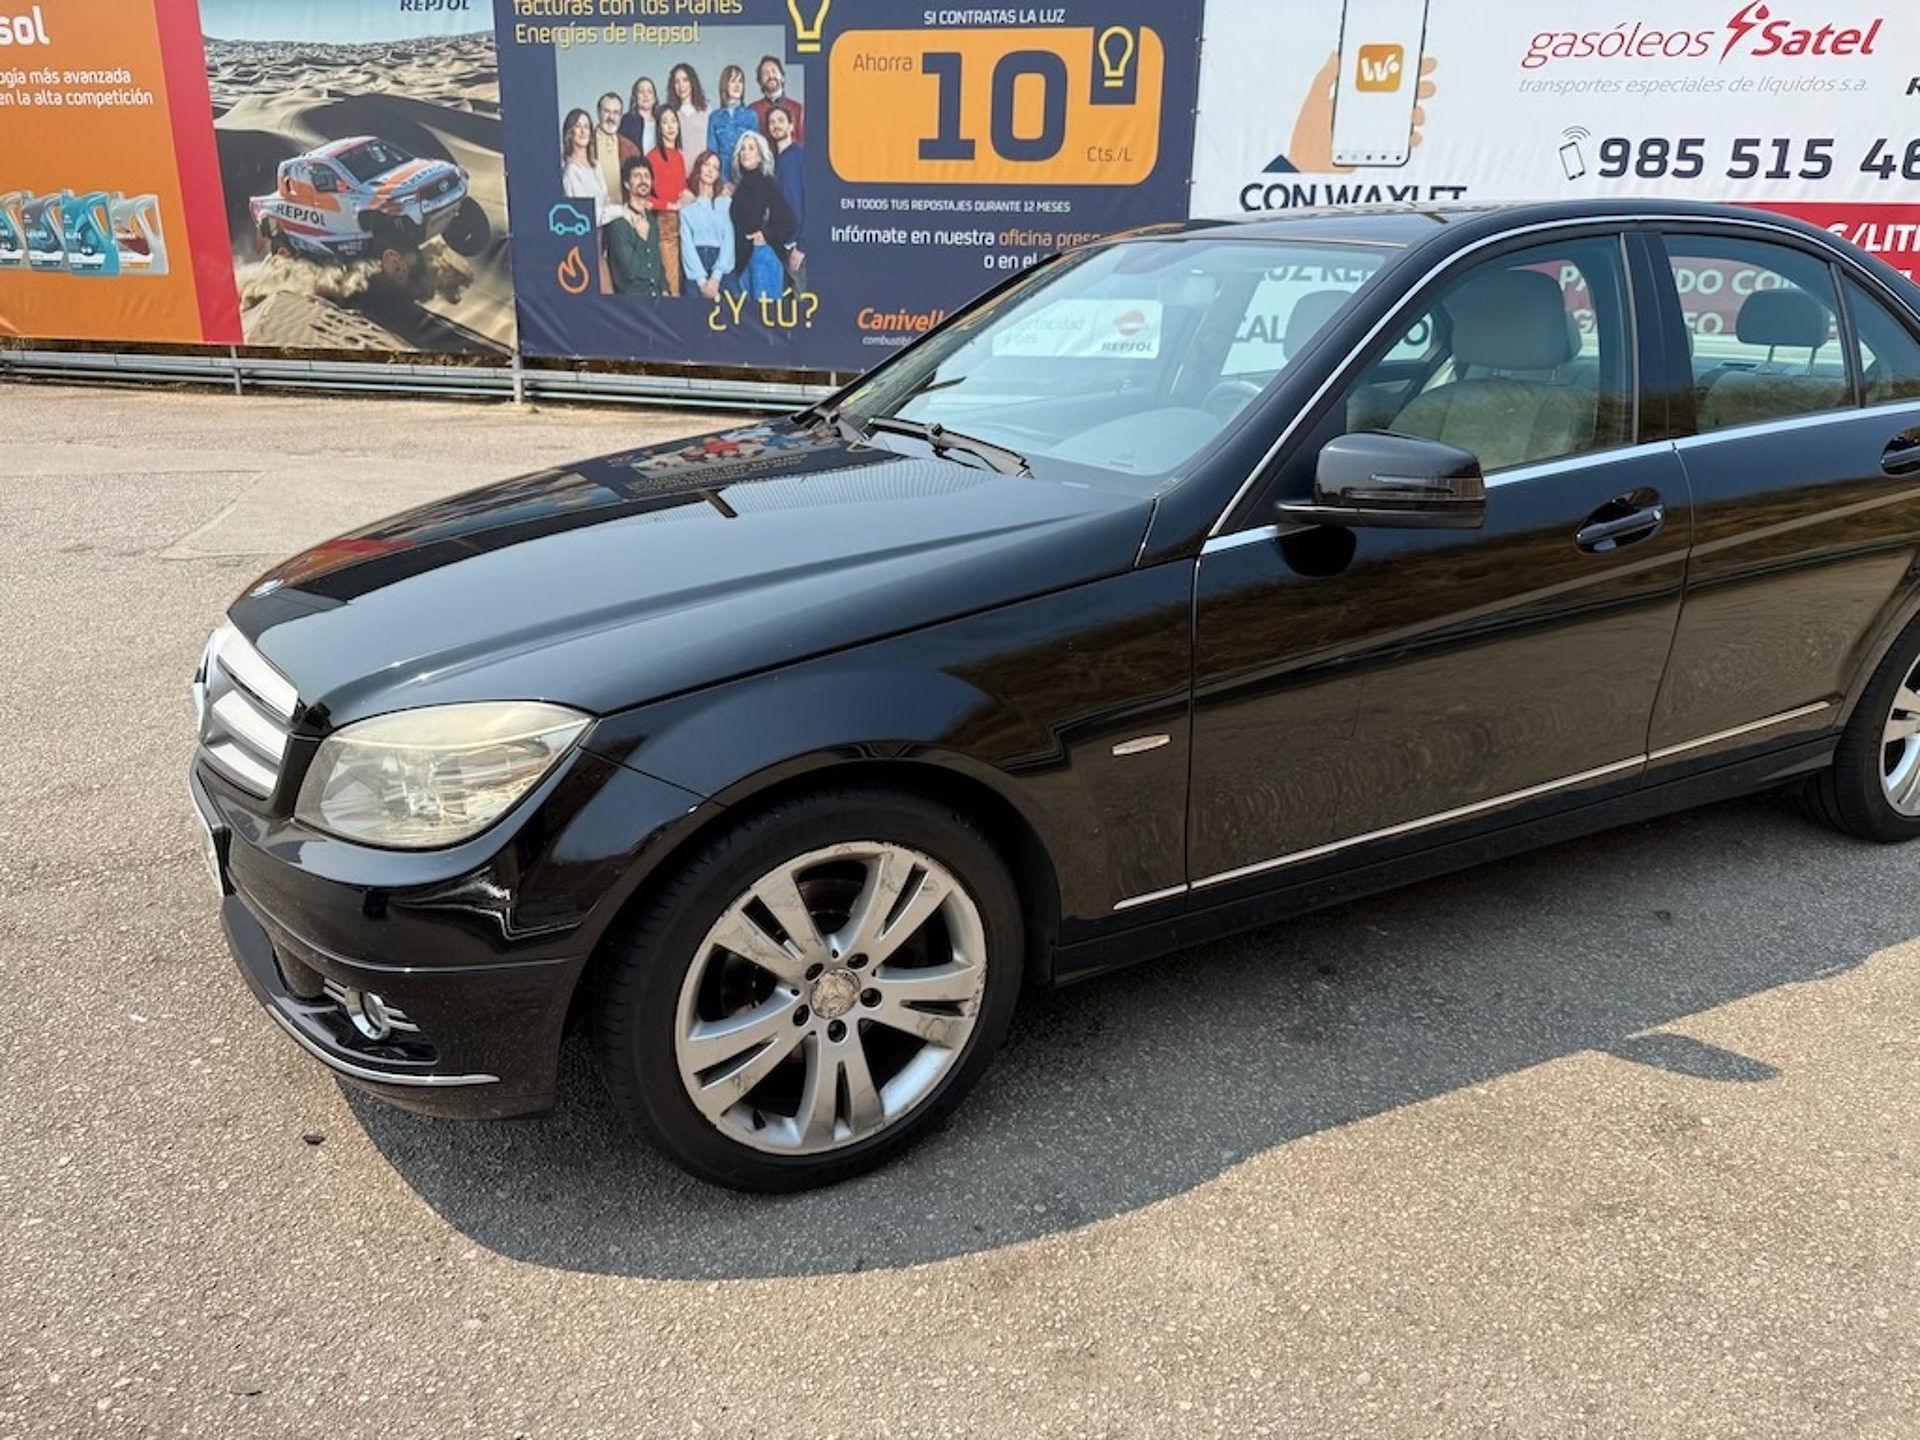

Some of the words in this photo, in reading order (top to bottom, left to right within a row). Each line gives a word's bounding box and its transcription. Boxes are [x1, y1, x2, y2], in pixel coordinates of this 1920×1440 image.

[513, 0, 593, 15] facturas
[600, 0, 634, 15] con
[641, 0, 669, 14] los
[675, 0, 743, 14] Planes
[924, 11, 936, 25] SI
[939, 10, 1016, 25] CONTRATAS
[1019, 9, 1036, 24] LA
[1039, 9, 1066, 23] LUZ
[0, 5, 50, 45] sol
[515, 22, 598, 49] Energías
[603, 22, 627, 42] de
[633, 21, 700, 46] Repsol
[1521, 22, 1715, 69] gasóleos
[1751, 18, 1884, 56] Satel
[853, 54, 913, 72] Ahorra
[30, 68, 60, 84] más
[63, 69, 131, 84] avanzada
[1518, 78, 1623, 96] transportes
[1625, 77, 1723, 96] especiales
[1728, 77, 1753, 93] de
[1757, 76, 1835, 96] líquidos
[1838, 79, 1868, 92] s.a.
[17, 89, 30, 105] la
[35, 90, 62, 105] alta
[65, 88, 153, 108] competición
[918, 50, 1069, 161] 10
[1086, 147, 1132, 163] Cts./L
[1599, 138, 1705, 179] 985
[1726, 138, 1834, 179] 515
[841, 198, 854, 209] EN
[857, 198, 889, 210] TODOS
[891, 199, 909, 210] TUS
[911, 200, 972, 212] REPOSTAJES
[974, 201, 1021, 212] DURANTE
[1023, 202, 1034, 212] 12
[1036, 202, 1071, 213] MESES
[1239, 183, 1317, 212] CON
[831, 226, 907, 245] Infórmate
[911, 230, 931, 245] en
[935, 231, 995, 246] nuestra
[999, 229, 1052, 247] oficina
[984, 255, 994, 269] o
[999, 255, 1018, 269] en
[708, 291, 747, 331] ¿Y
[760, 288, 819, 328] tú?
[1101, 341, 1153, 352] REPSOL
